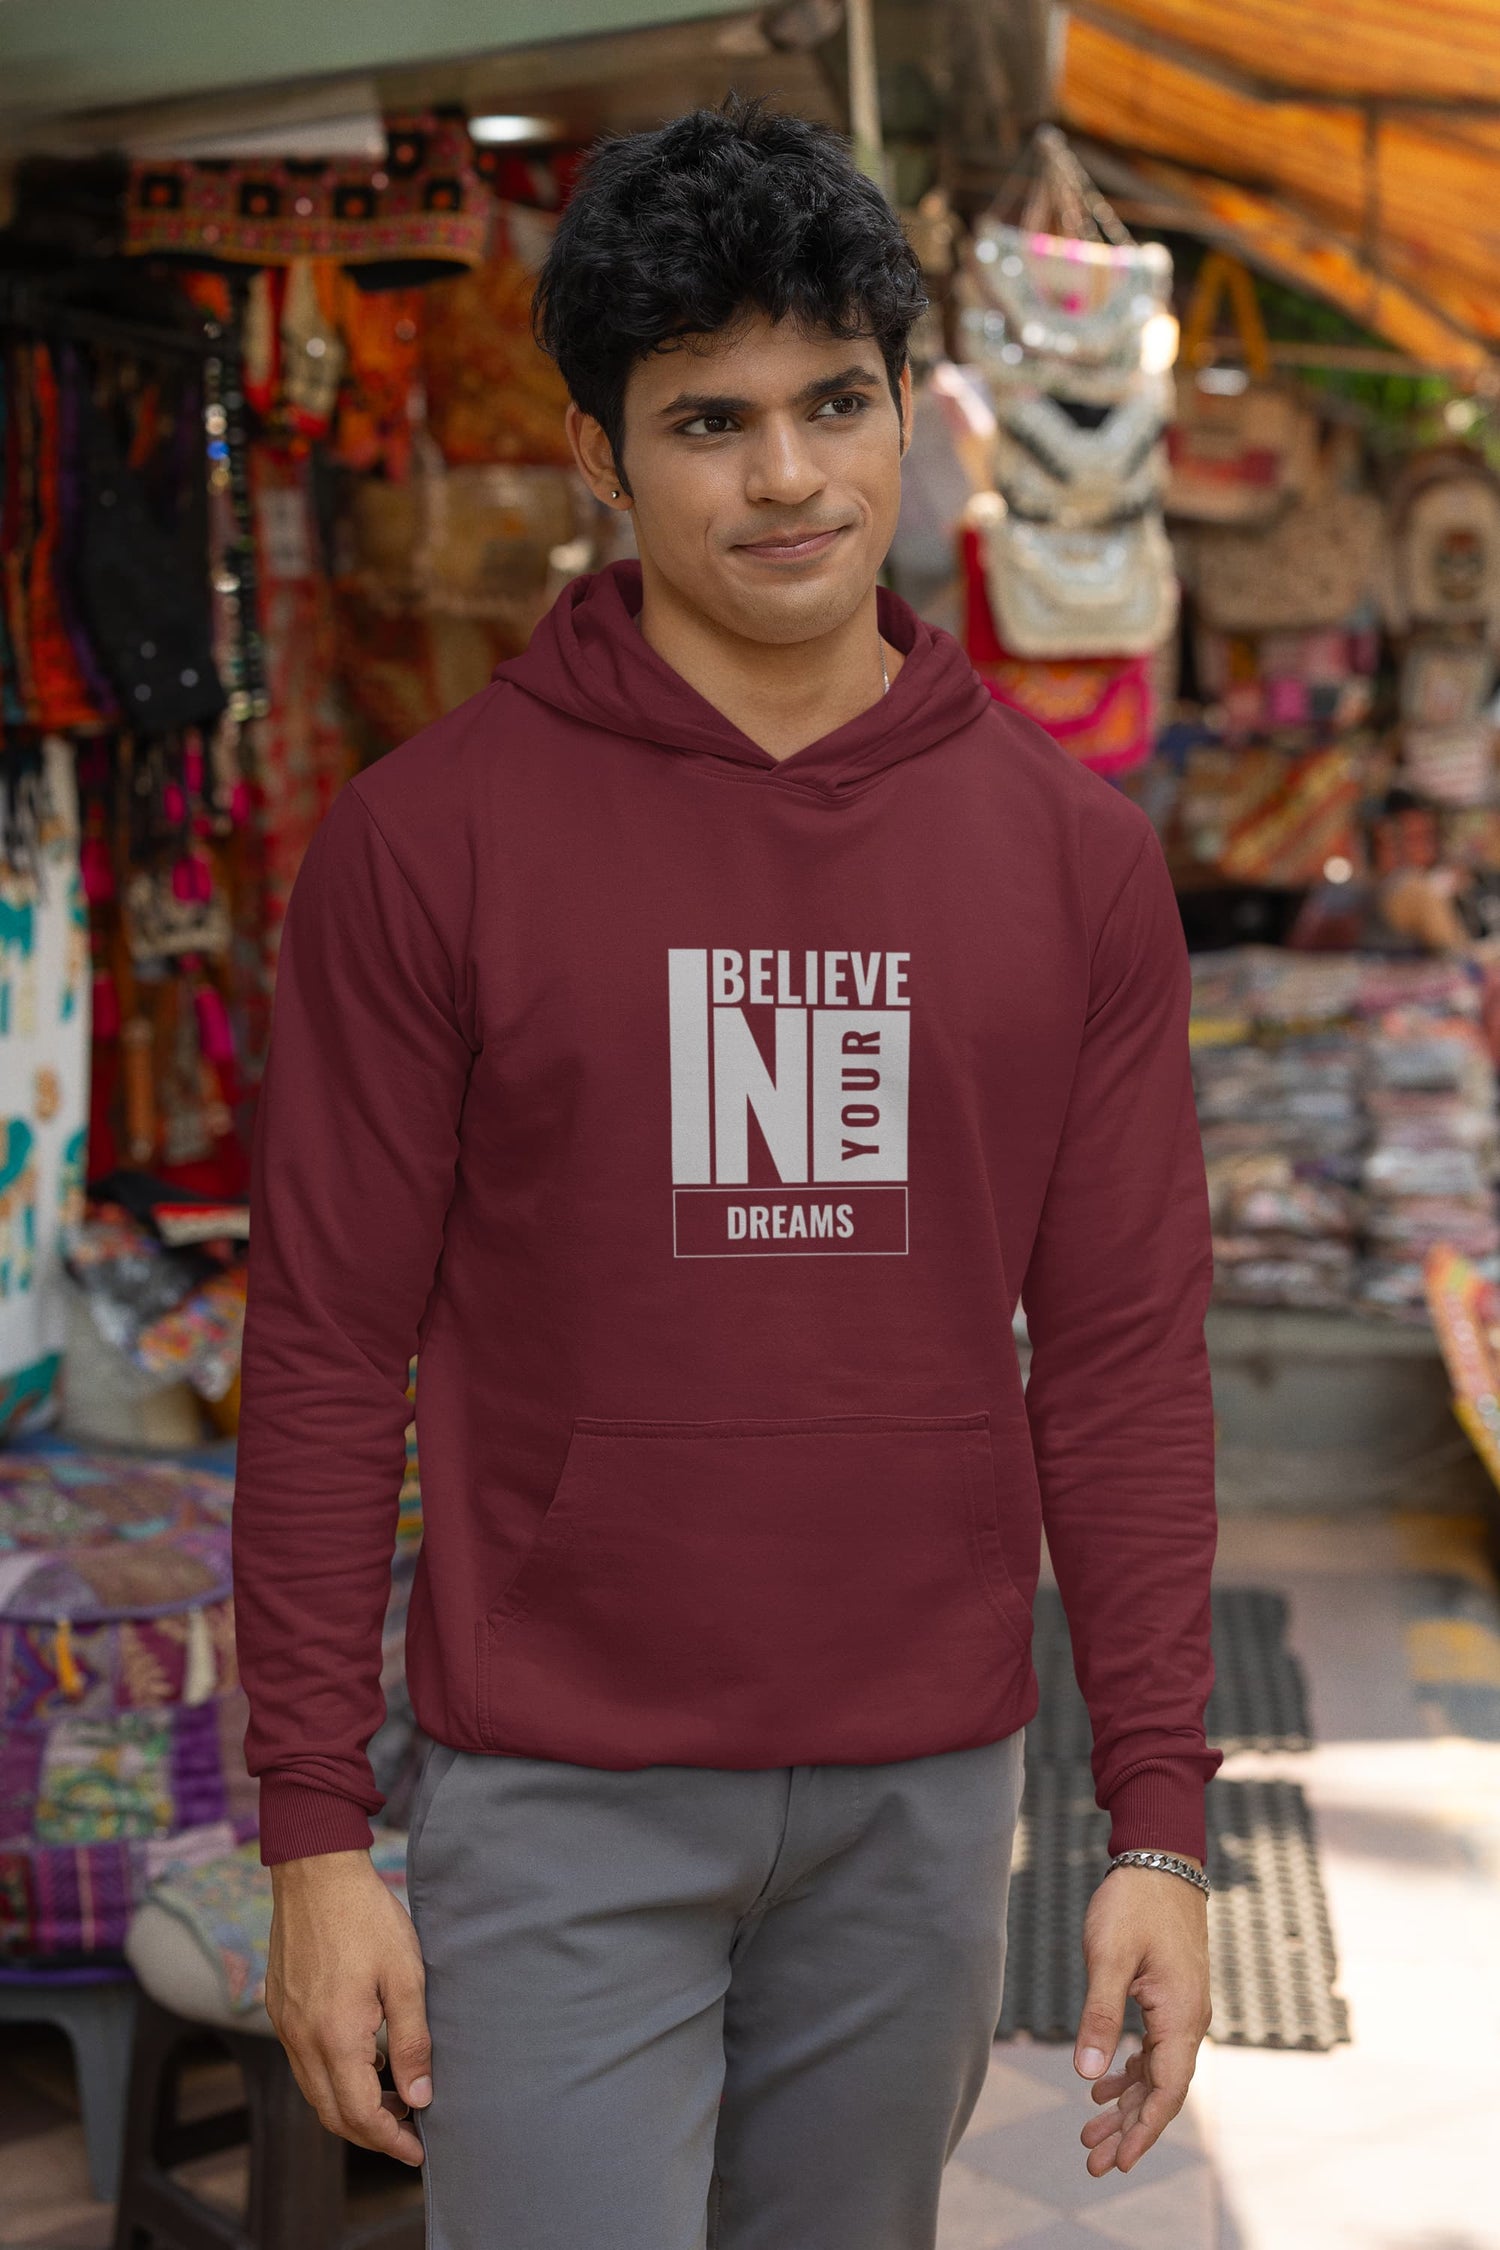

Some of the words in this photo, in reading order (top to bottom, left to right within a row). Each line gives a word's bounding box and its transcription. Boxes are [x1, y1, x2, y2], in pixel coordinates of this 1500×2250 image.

[712, 948, 911, 1006] BELIEVE
[668, 948, 809, 1185] IN
[841, 1030, 881, 1161] YOUR
[727, 1204, 855, 1240] DREAMS
